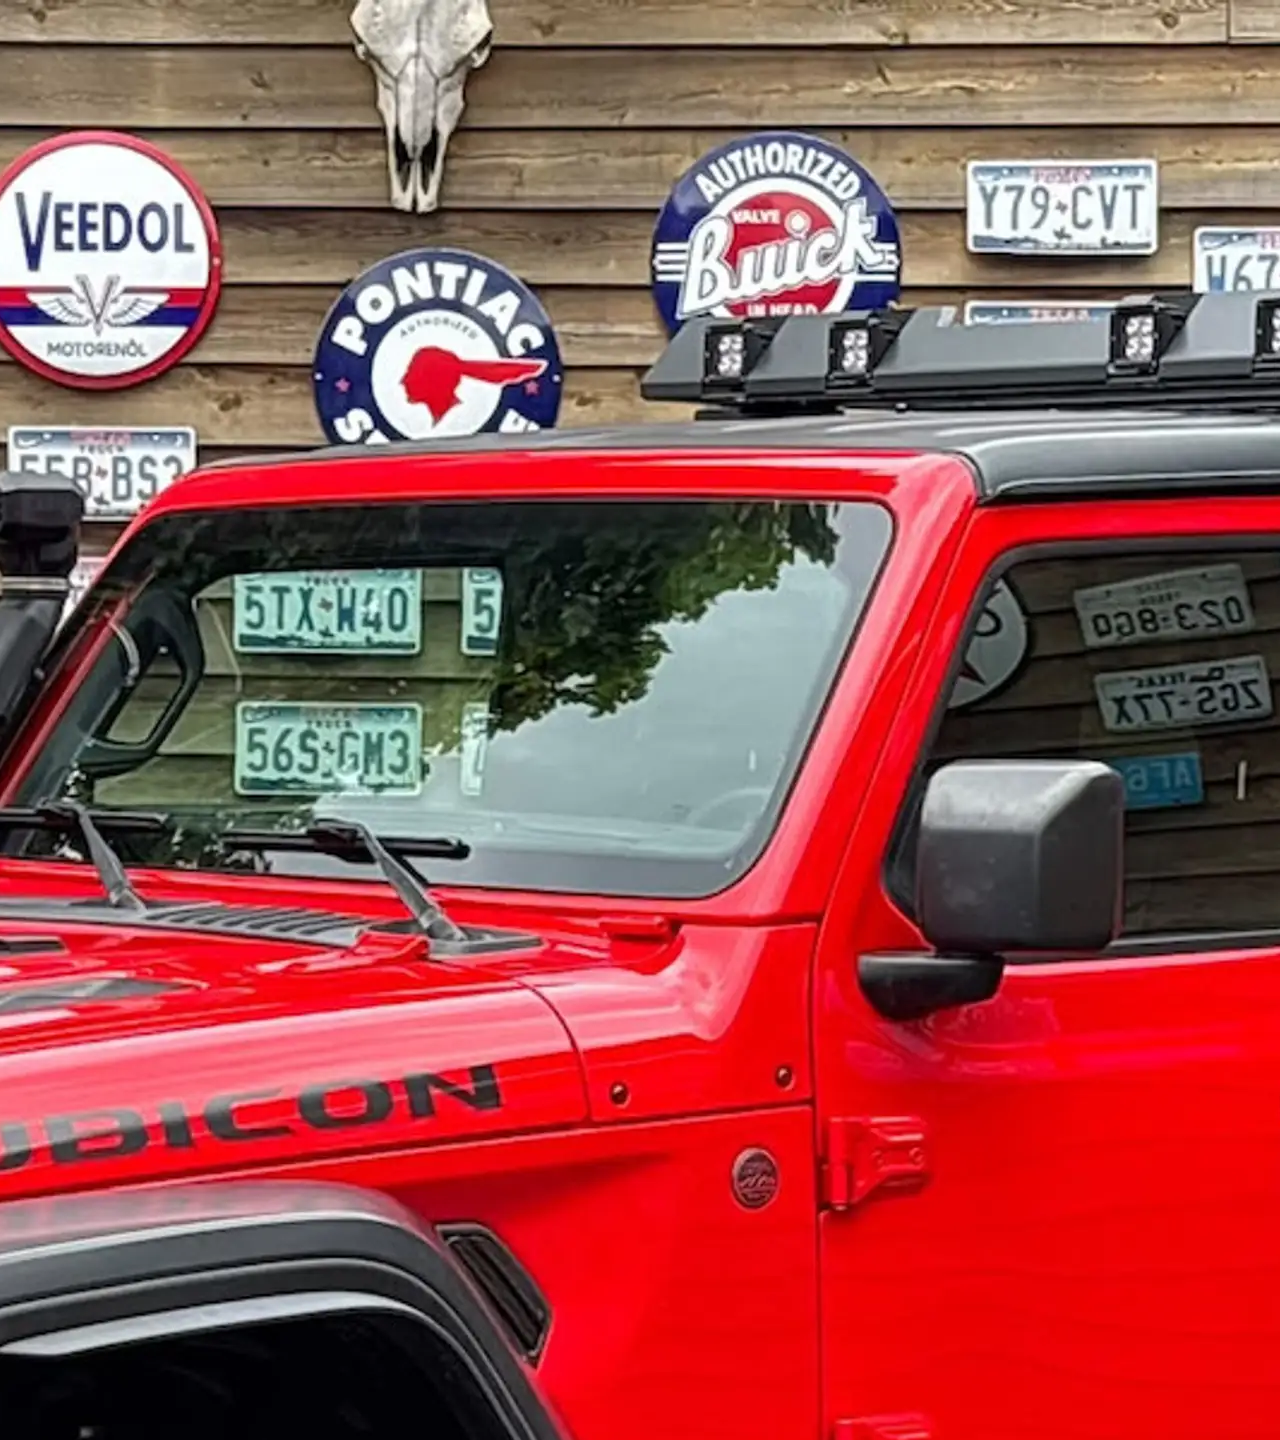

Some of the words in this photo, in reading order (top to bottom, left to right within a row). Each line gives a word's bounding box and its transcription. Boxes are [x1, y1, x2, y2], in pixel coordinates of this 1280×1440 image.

[695, 141, 860, 203] AUTHORIZED
[15, 191, 195, 271] VEEDOL
[731, 208, 781, 225] VALVE
[677, 196, 884, 321] Buick
[331, 260, 546, 357] PONTIAC
[399, 316, 481, 339] AUTHORIZED
[47, 339, 147, 359] MOTORENÖL
